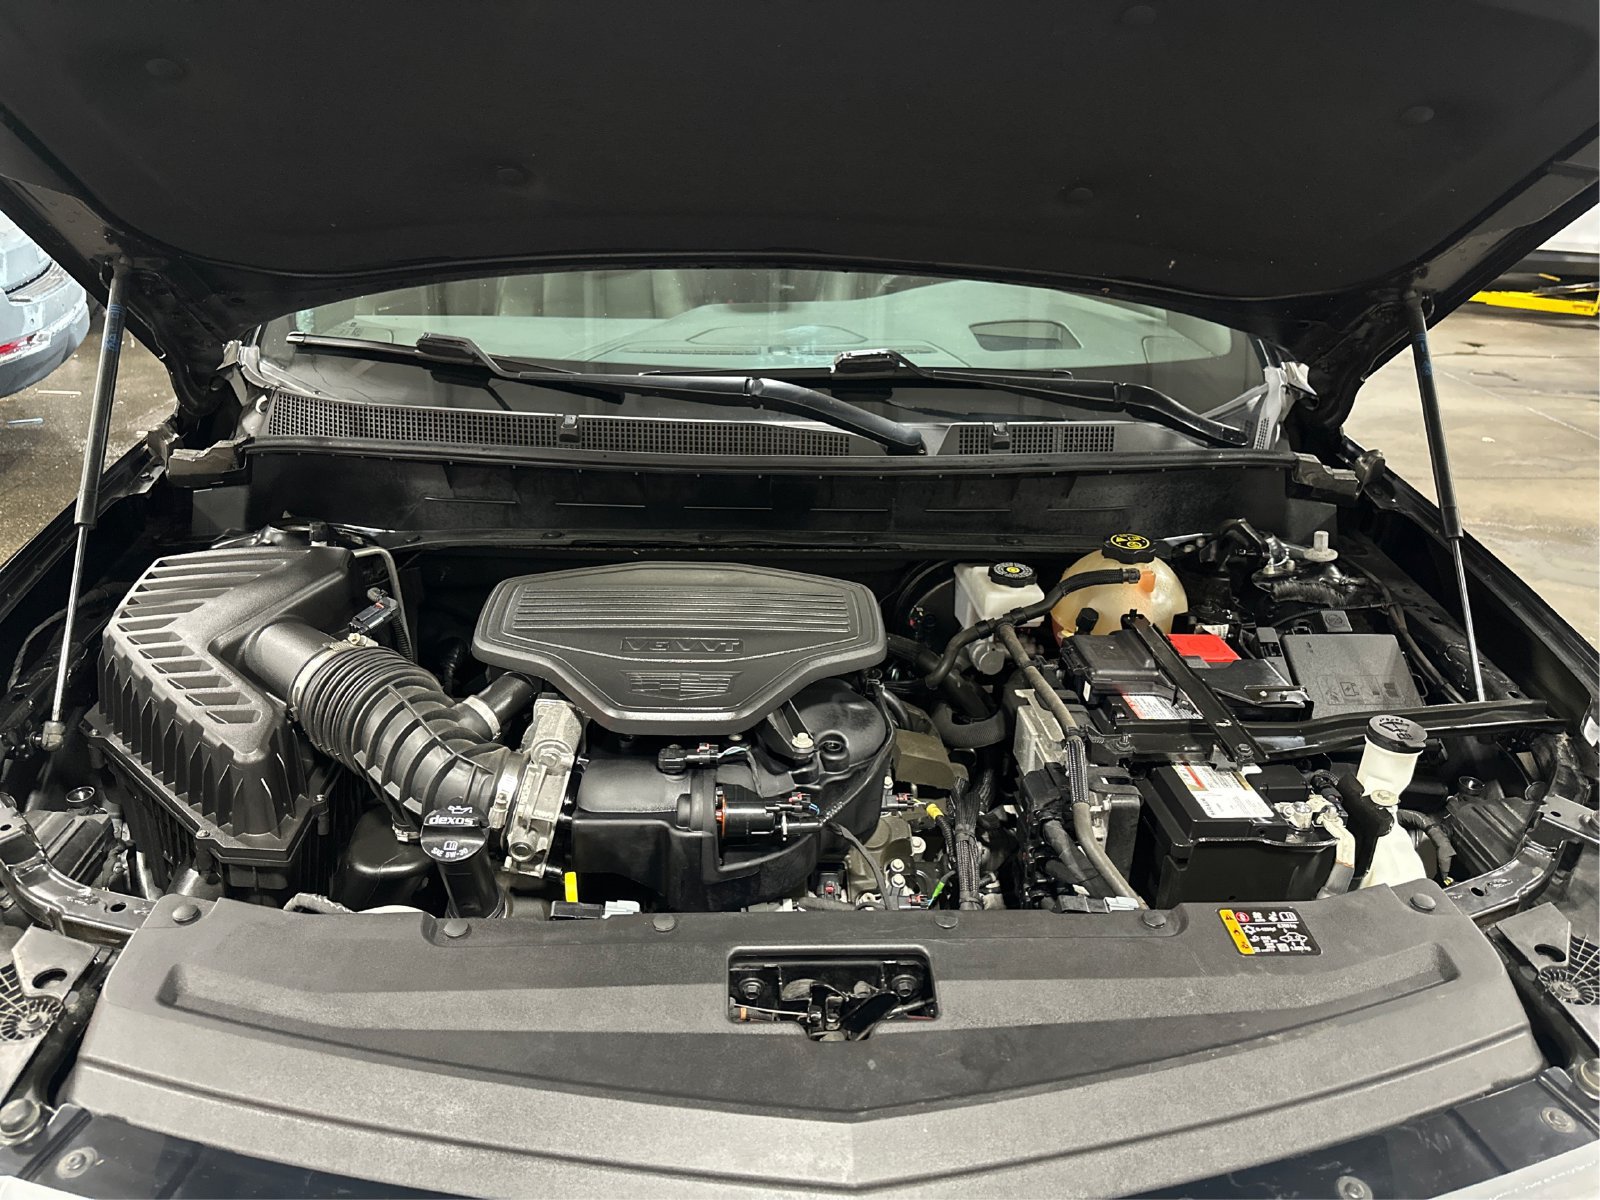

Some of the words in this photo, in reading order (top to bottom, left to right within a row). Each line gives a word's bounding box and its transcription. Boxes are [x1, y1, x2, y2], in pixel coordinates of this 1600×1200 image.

[429, 814, 474, 826] dexos
[431, 847, 444, 857] SAE
[445, 847, 468, 858] 5W-30
